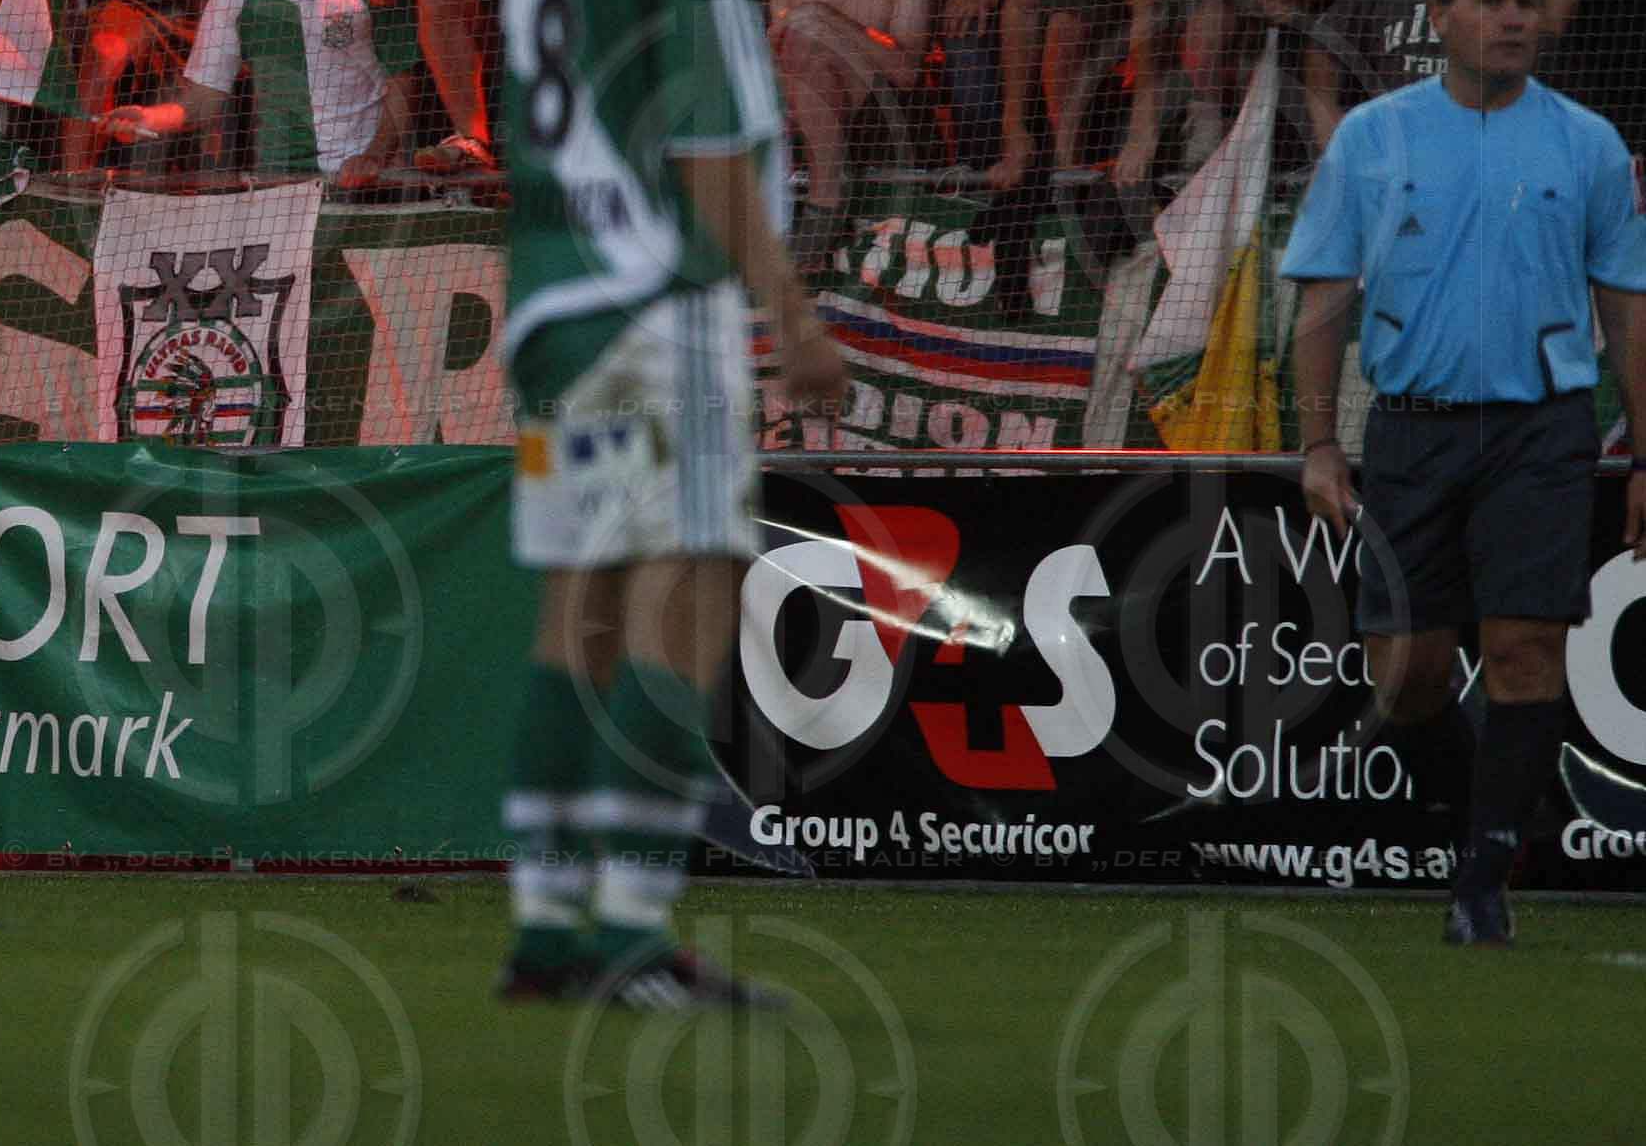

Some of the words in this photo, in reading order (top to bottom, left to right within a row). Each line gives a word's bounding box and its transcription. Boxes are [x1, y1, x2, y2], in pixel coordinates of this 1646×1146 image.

[1196, 506, 1253, 585] A
[1199, 622, 1258, 686] of
[1187, 719, 1412, 800] Solutio
[749, 805, 879, 861] Group
[890, 811, 911, 850] 4
[919, 812, 1095, 855] Securicor
